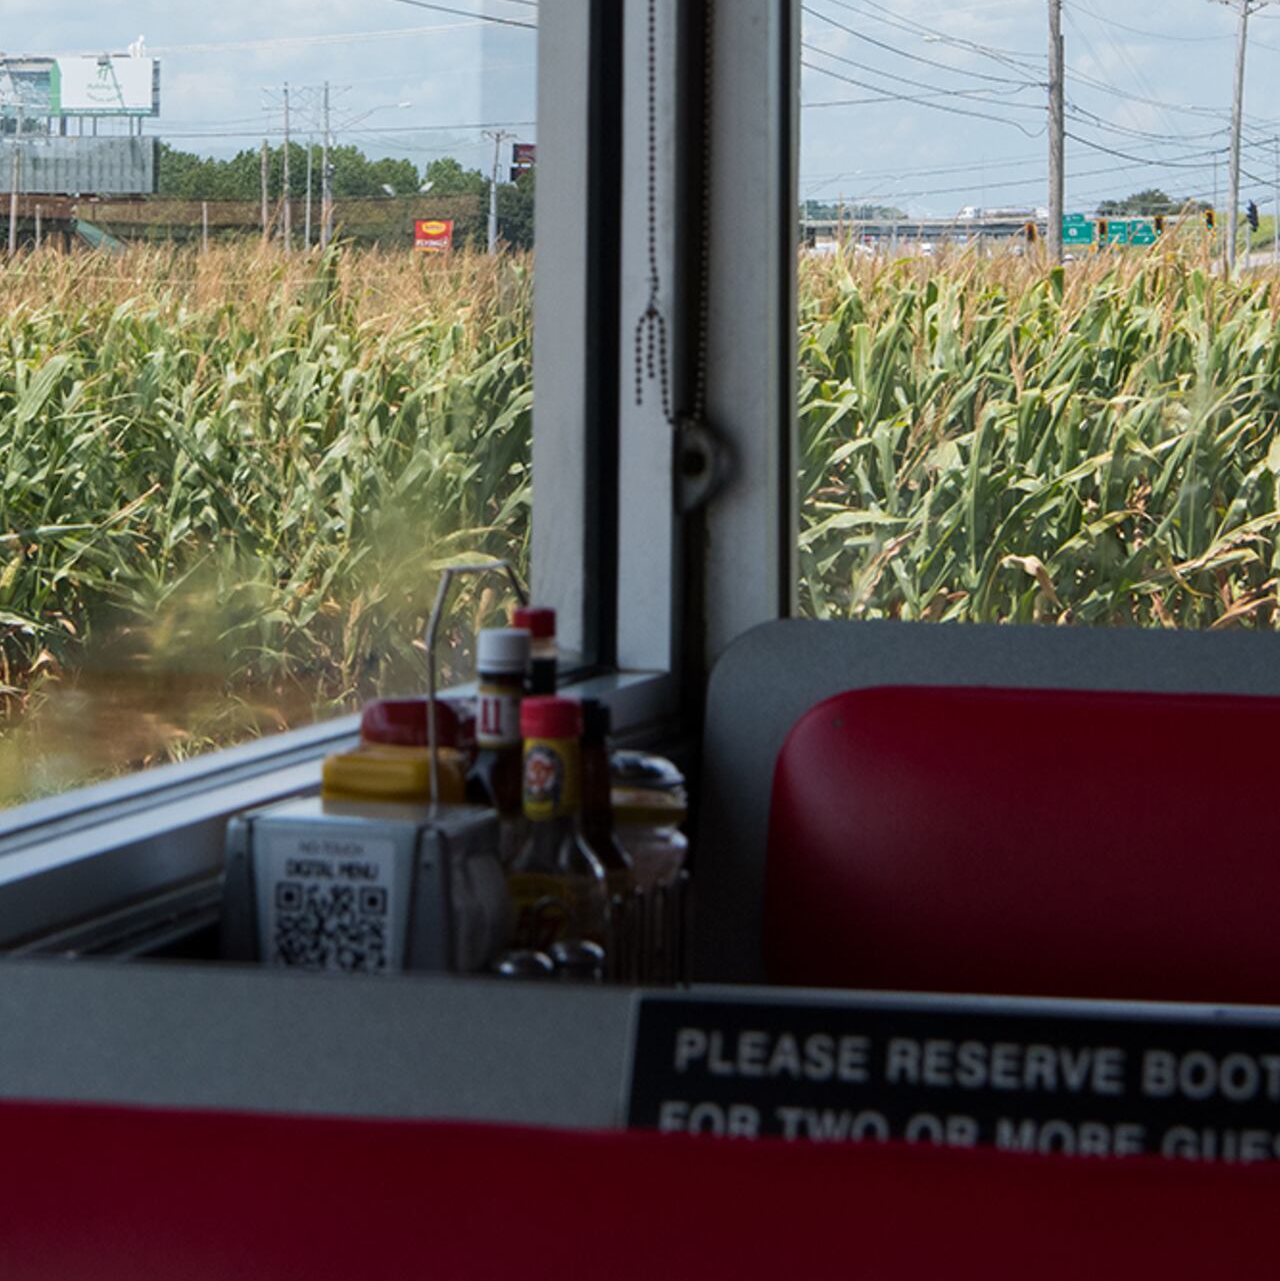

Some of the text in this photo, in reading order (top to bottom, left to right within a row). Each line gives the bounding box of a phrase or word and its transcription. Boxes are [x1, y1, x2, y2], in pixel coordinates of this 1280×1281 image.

[286, 859, 379, 880] DIGITAL MENU
[672, 1026, 873, 1084] PLEASE
[884, 1037, 1128, 1097] RESERVE
[658, 1099, 762, 1142] FOR
[776, 1105, 892, 1145] TWO
[903, 1112, 980, 1149] OR
[994, 1116, 1148, 1158] MORE
